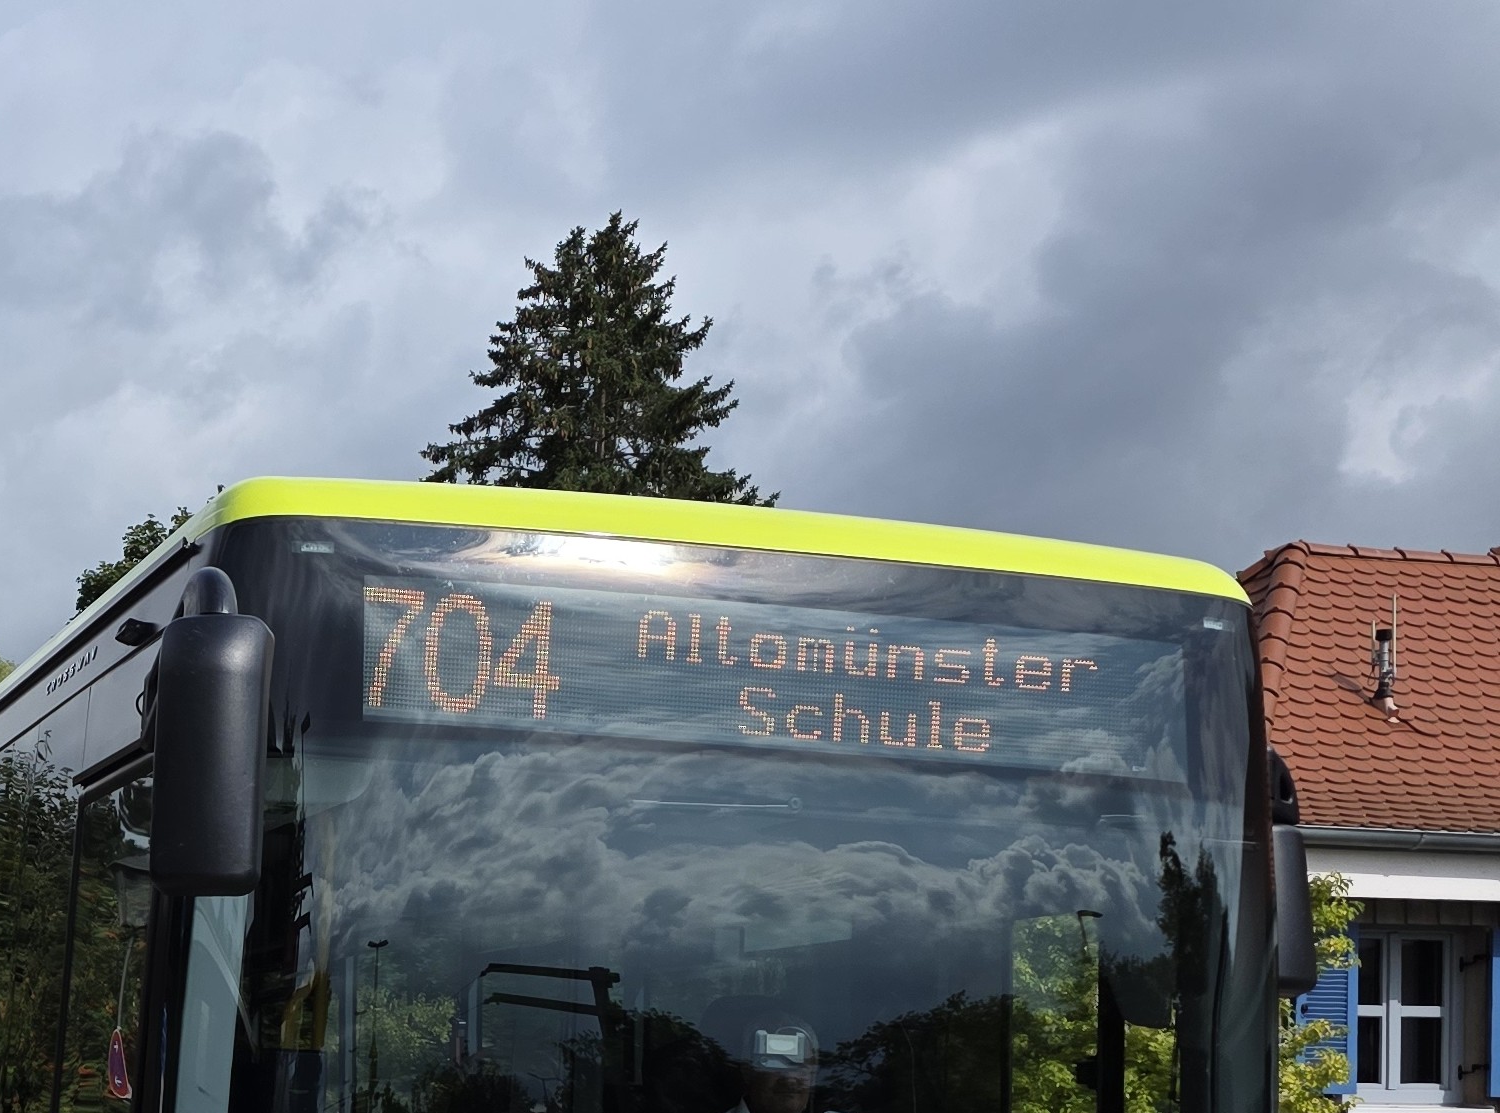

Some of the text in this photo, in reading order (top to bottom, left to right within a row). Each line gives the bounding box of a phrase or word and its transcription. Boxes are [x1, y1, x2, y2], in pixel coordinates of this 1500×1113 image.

[362, 584, 1098, 720] 704 Altomünster
[737, 686, 993, 753] Schule
